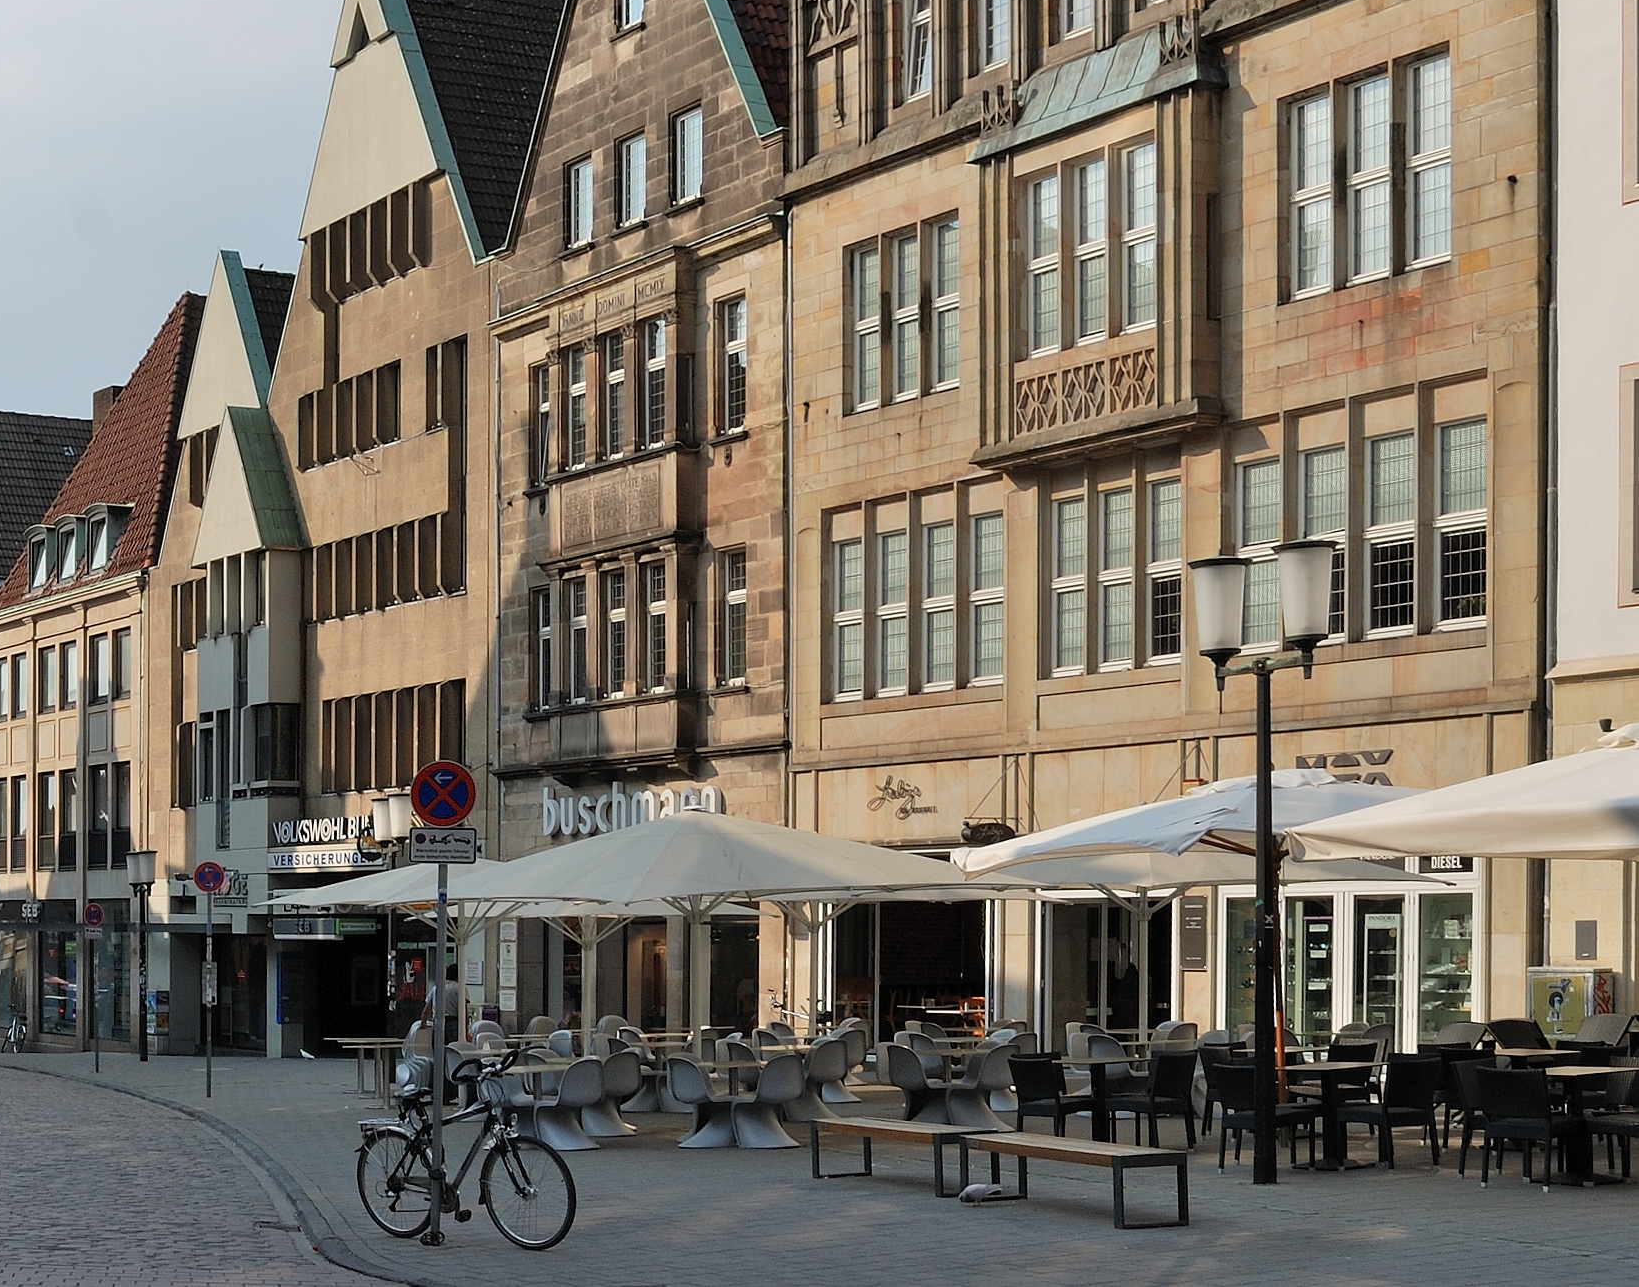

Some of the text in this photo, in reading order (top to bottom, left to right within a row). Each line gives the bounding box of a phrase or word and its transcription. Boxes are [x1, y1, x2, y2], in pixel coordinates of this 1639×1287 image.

[543, 781, 722, 836] buschmann
[272, 816, 347, 844] VOLKSWOHL
[274, 850, 373, 866] VERSICHERUNG
[1430, 856, 1463, 869] DIESEL
[21, 903, 39, 918] SEB
